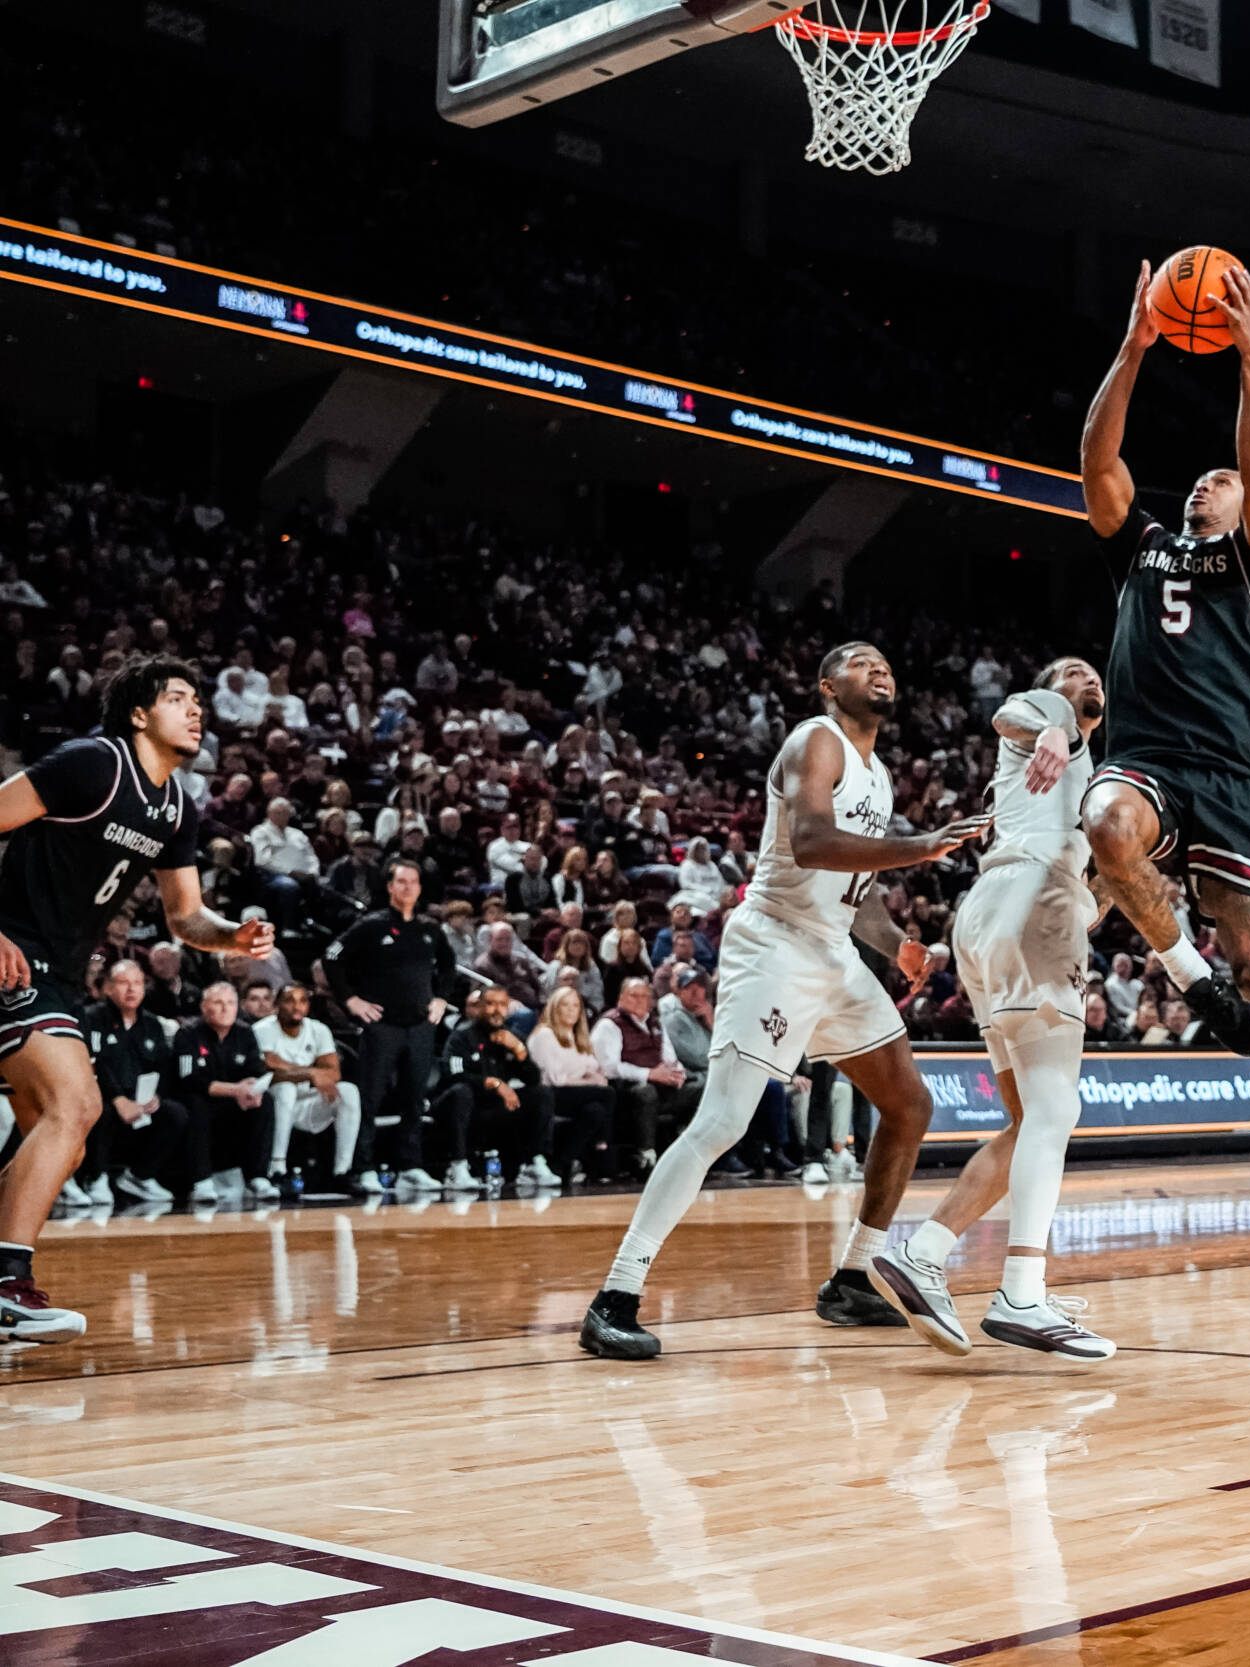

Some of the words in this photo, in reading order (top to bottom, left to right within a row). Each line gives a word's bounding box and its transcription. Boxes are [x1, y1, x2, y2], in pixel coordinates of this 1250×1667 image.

[25, 244, 103, 278] tailored
[356, 321, 445, 357] Orthopedic
[731, 409, 801, 440] Orthopedic
[1160, 579, 1192, 635] 5
[94, 858, 130, 905] 6
[1078, 1074, 1186, 1111] thopedic
[1186, 1080, 1235, 1101] care
